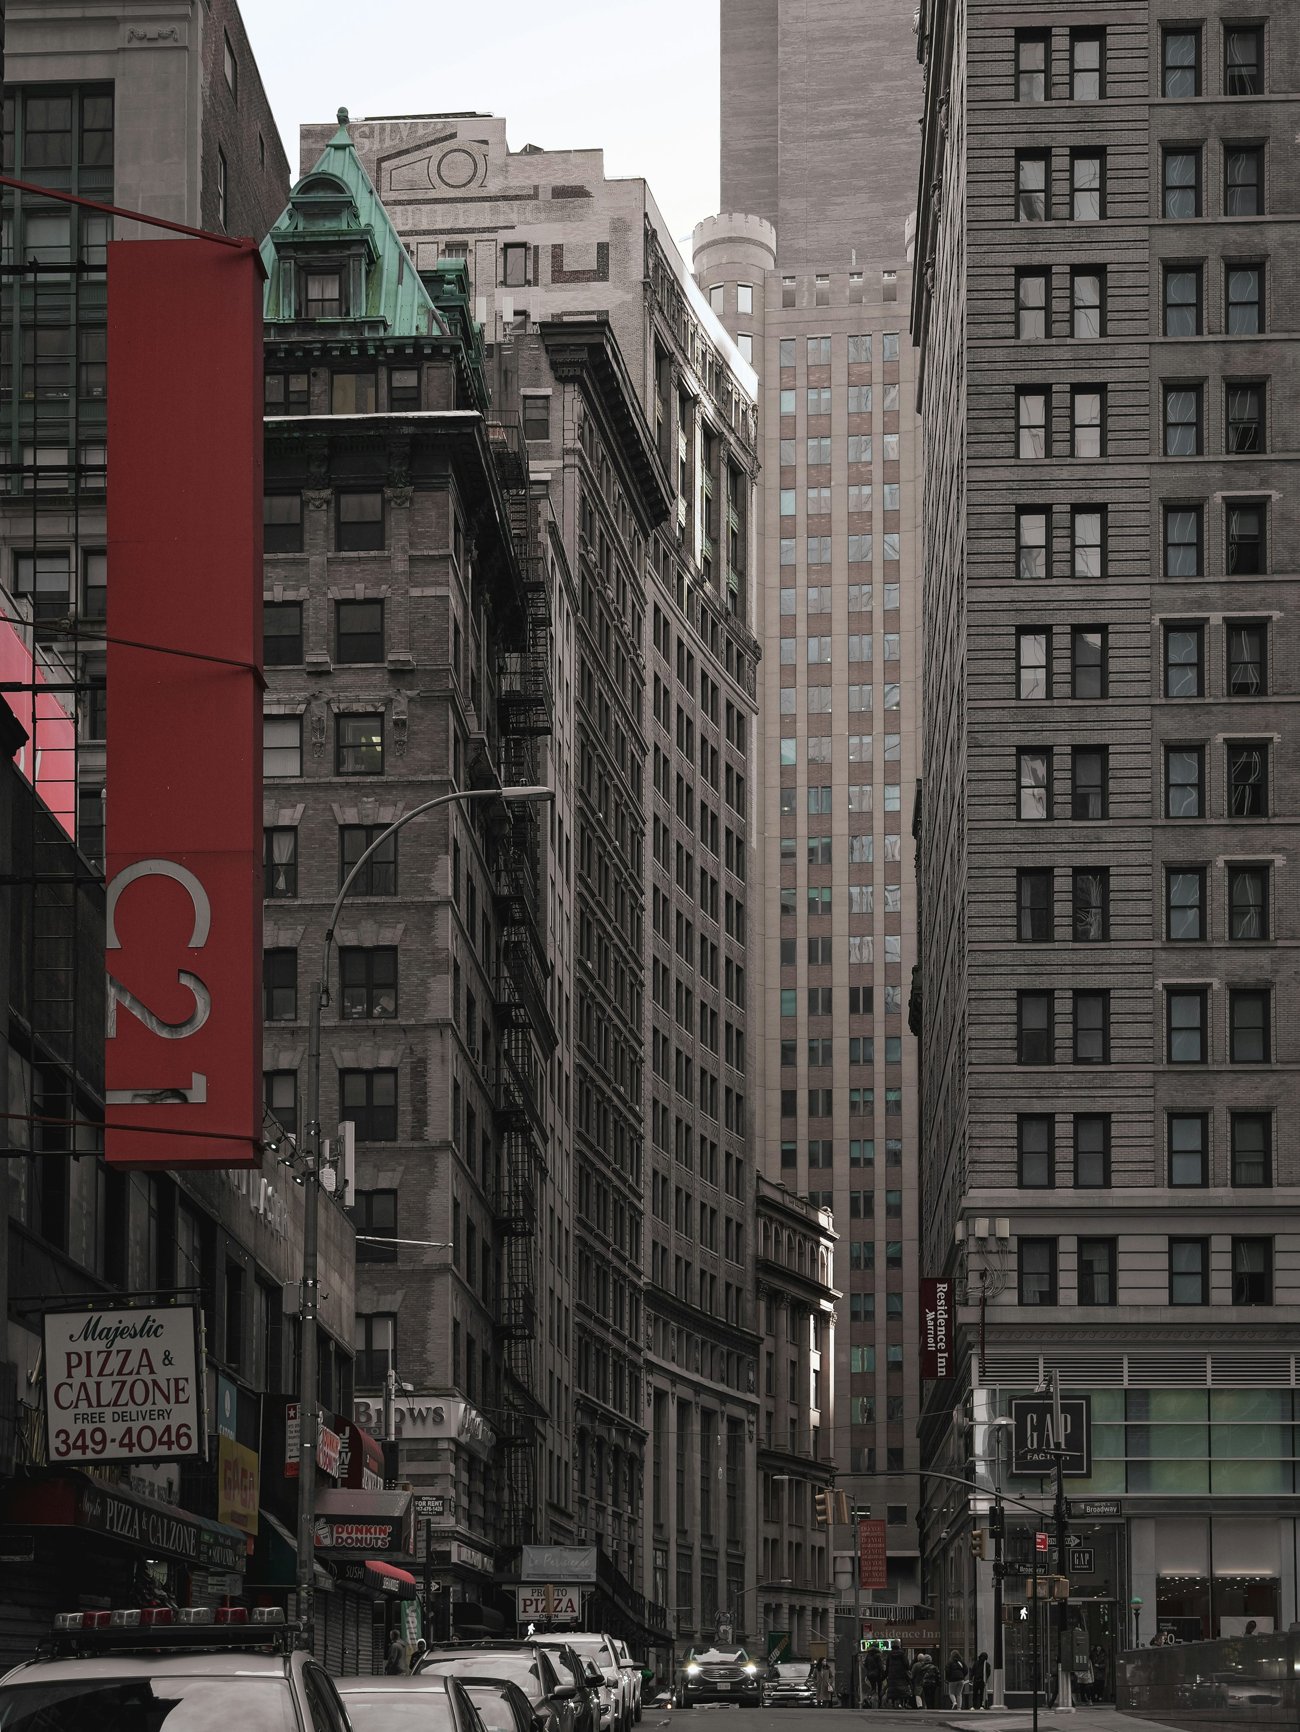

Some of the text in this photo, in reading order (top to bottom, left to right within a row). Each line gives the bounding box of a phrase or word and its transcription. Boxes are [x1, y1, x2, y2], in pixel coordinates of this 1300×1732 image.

[106, 858, 212, 1104] C21
[69, 1315, 164, 1349] Majestic
[925, 1308, 936, 1351] Marriott
[936, 1282, 949, 1377] Residence Inn
[65, 1348, 174, 1379] PIZZA &
[54, 1377, 190, 1410] CALZONE
[73, 1409, 173, 1424] FREE DELIVERY
[1027, 1413, 1072, 1449] GAP
[54, 1423, 192, 1457] 349-4046
[338, 1426, 353, 1479] JEWE
[1086, 1505, 1118, 1514] Broadway
[105, 1497, 141, 1541] PIZZA
[149, 1513, 197, 1557] CALZONE
[334, 1524, 393, 1537] DUNKIN'
[334, 1535, 391, 1548] DONUTS
[1074, 1552, 1090, 1566] GAP
[531, 1588, 568, 1598] PRTO
